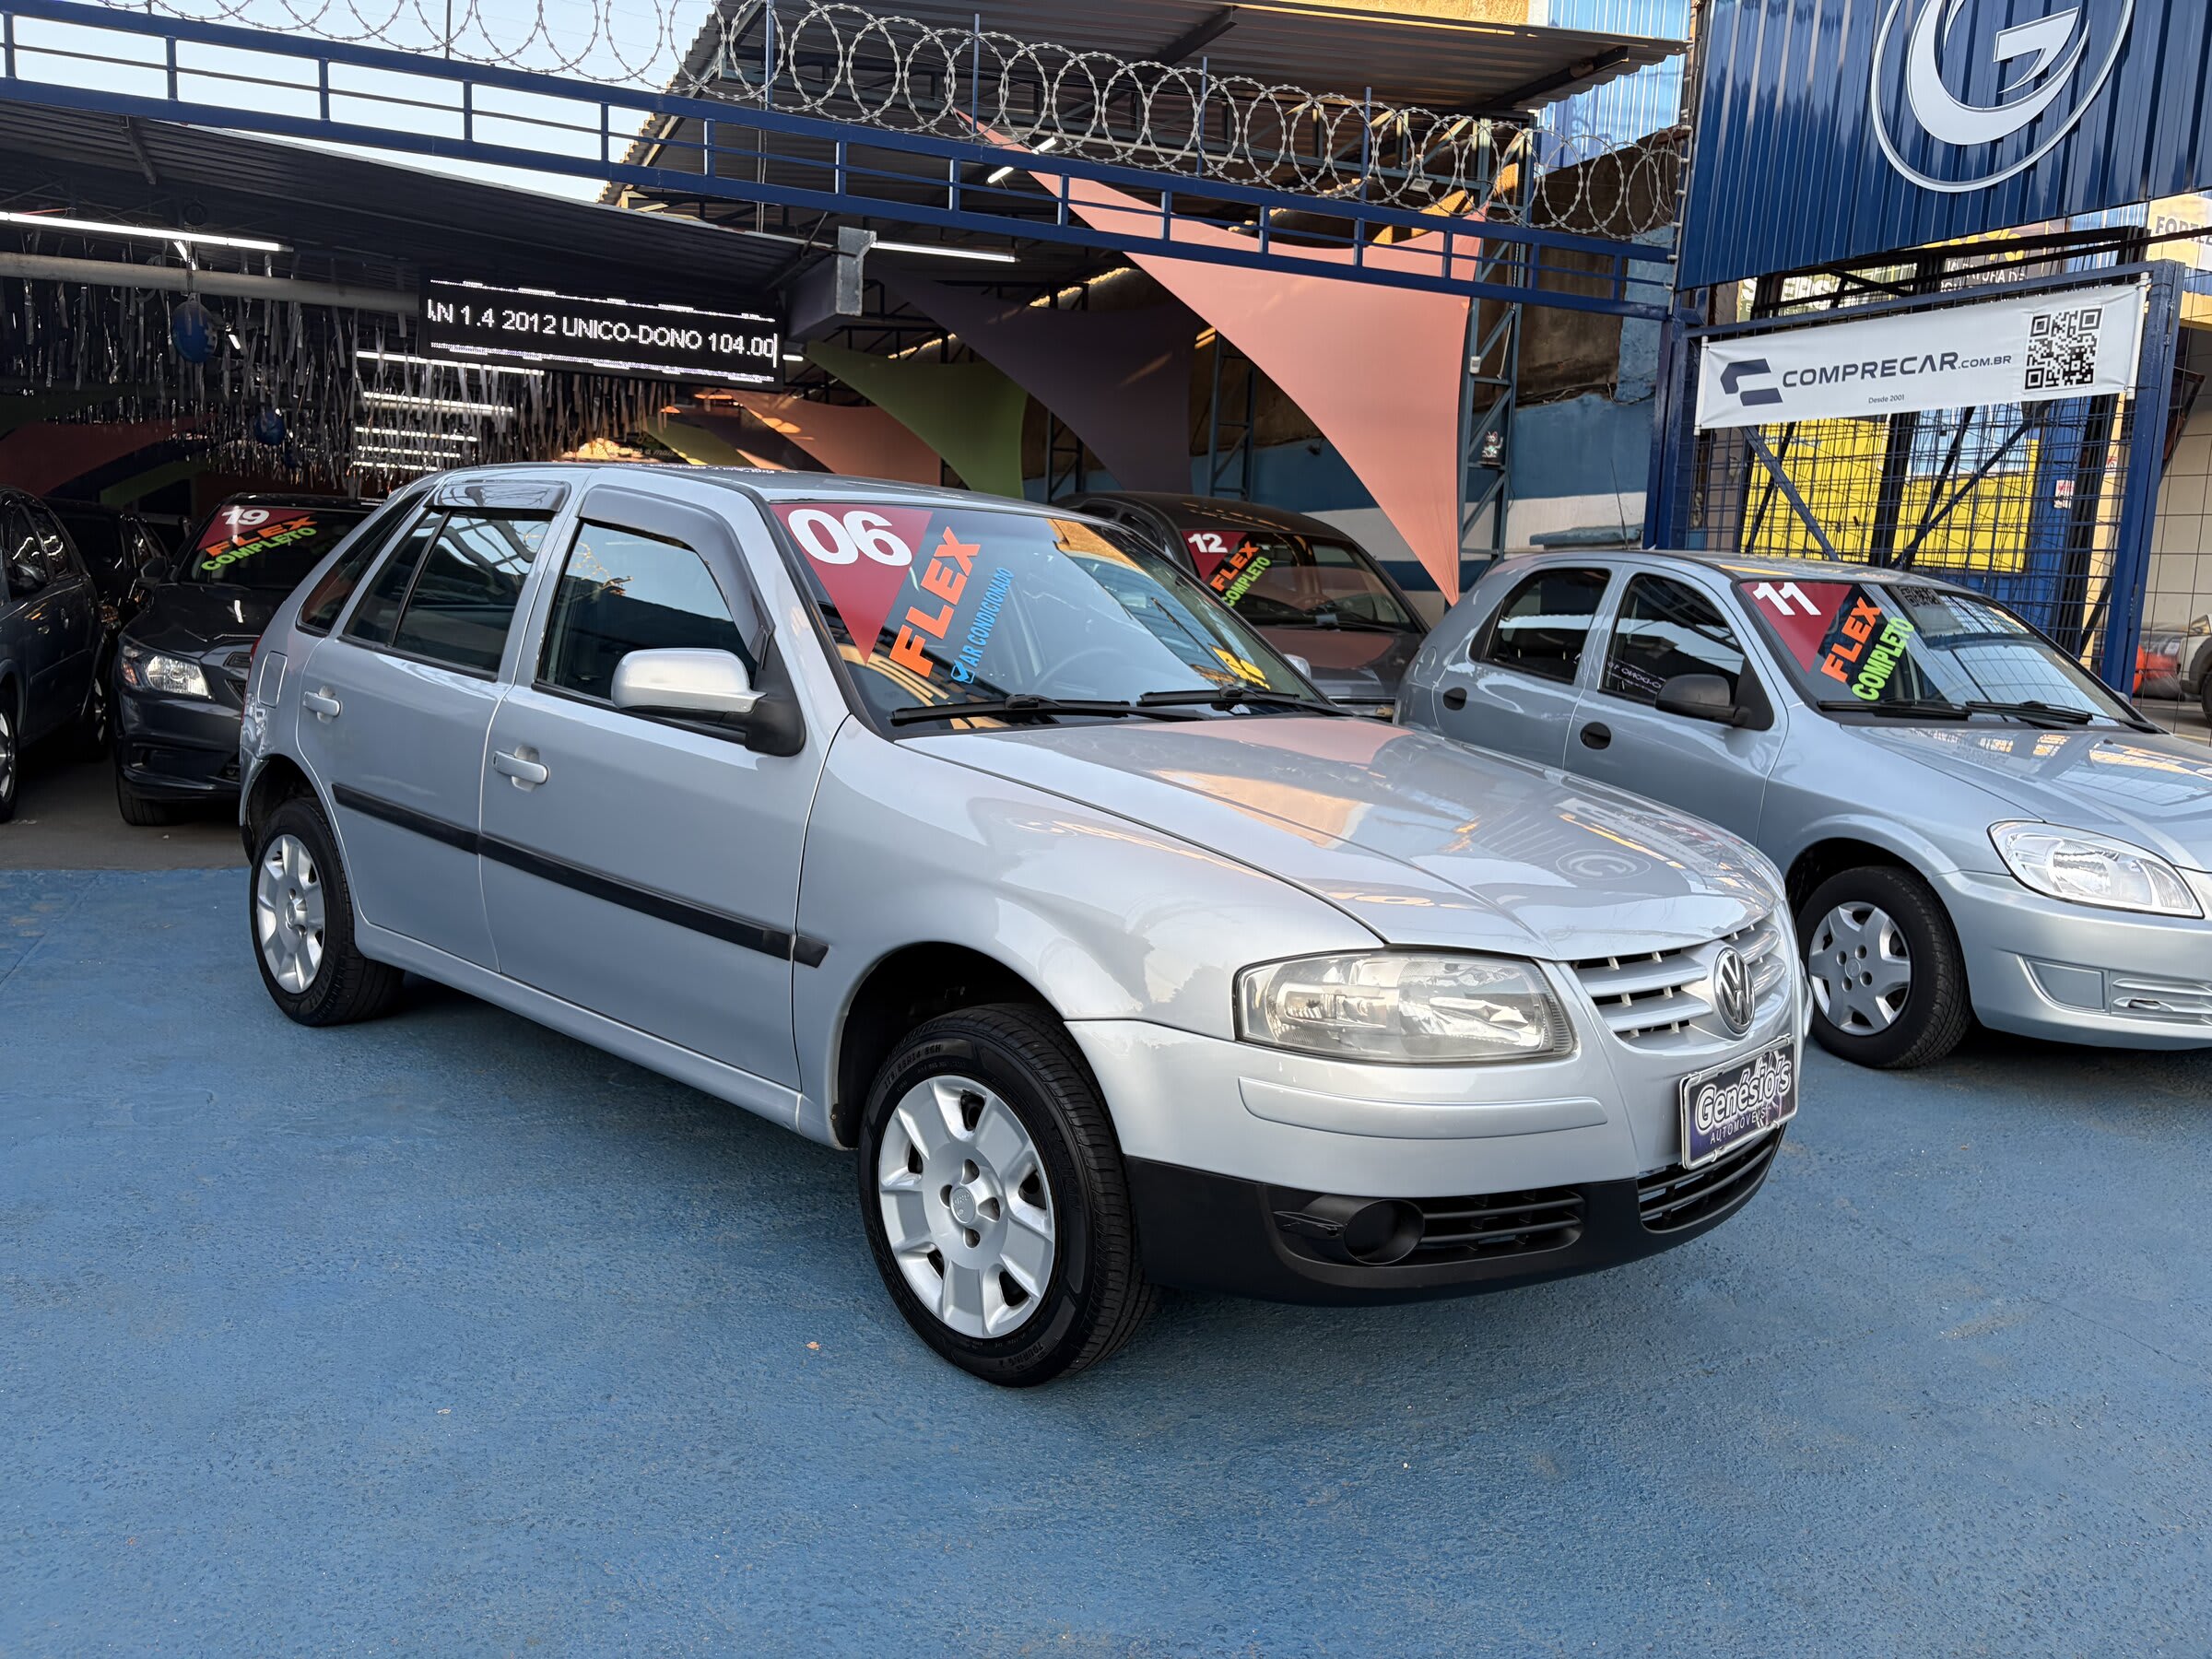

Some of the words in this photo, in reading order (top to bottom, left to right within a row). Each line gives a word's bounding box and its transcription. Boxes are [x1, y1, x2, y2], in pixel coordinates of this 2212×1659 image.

[1907, 0, 2089, 146] G
[461, 305, 495, 328] 1.4
[501, 310, 557, 335] 2012
[561, 316, 702, 350] UNICO-DONO
[1889, 394, 1905, 402] 2001
[206, 515, 318, 558] FLEX
[221, 507, 270, 526] 19
[787, 508, 913, 567] 06
[201, 527, 317, 571] COMPLETO
[1187, 533, 1229, 554] 12
[1209, 540, 1260, 592] FLEX
[888, 525, 982, 678] FLEX
[1220, 556, 1271, 607] COMPLETO
[1752, 582, 1822, 616] 11
[967, 567, 1015, 647] CONDICIONADO
[959, 645, 984, 668] AR
[1820, 596, 1882, 684] FLEX
[1852, 617, 1915, 701] COMPLETO
